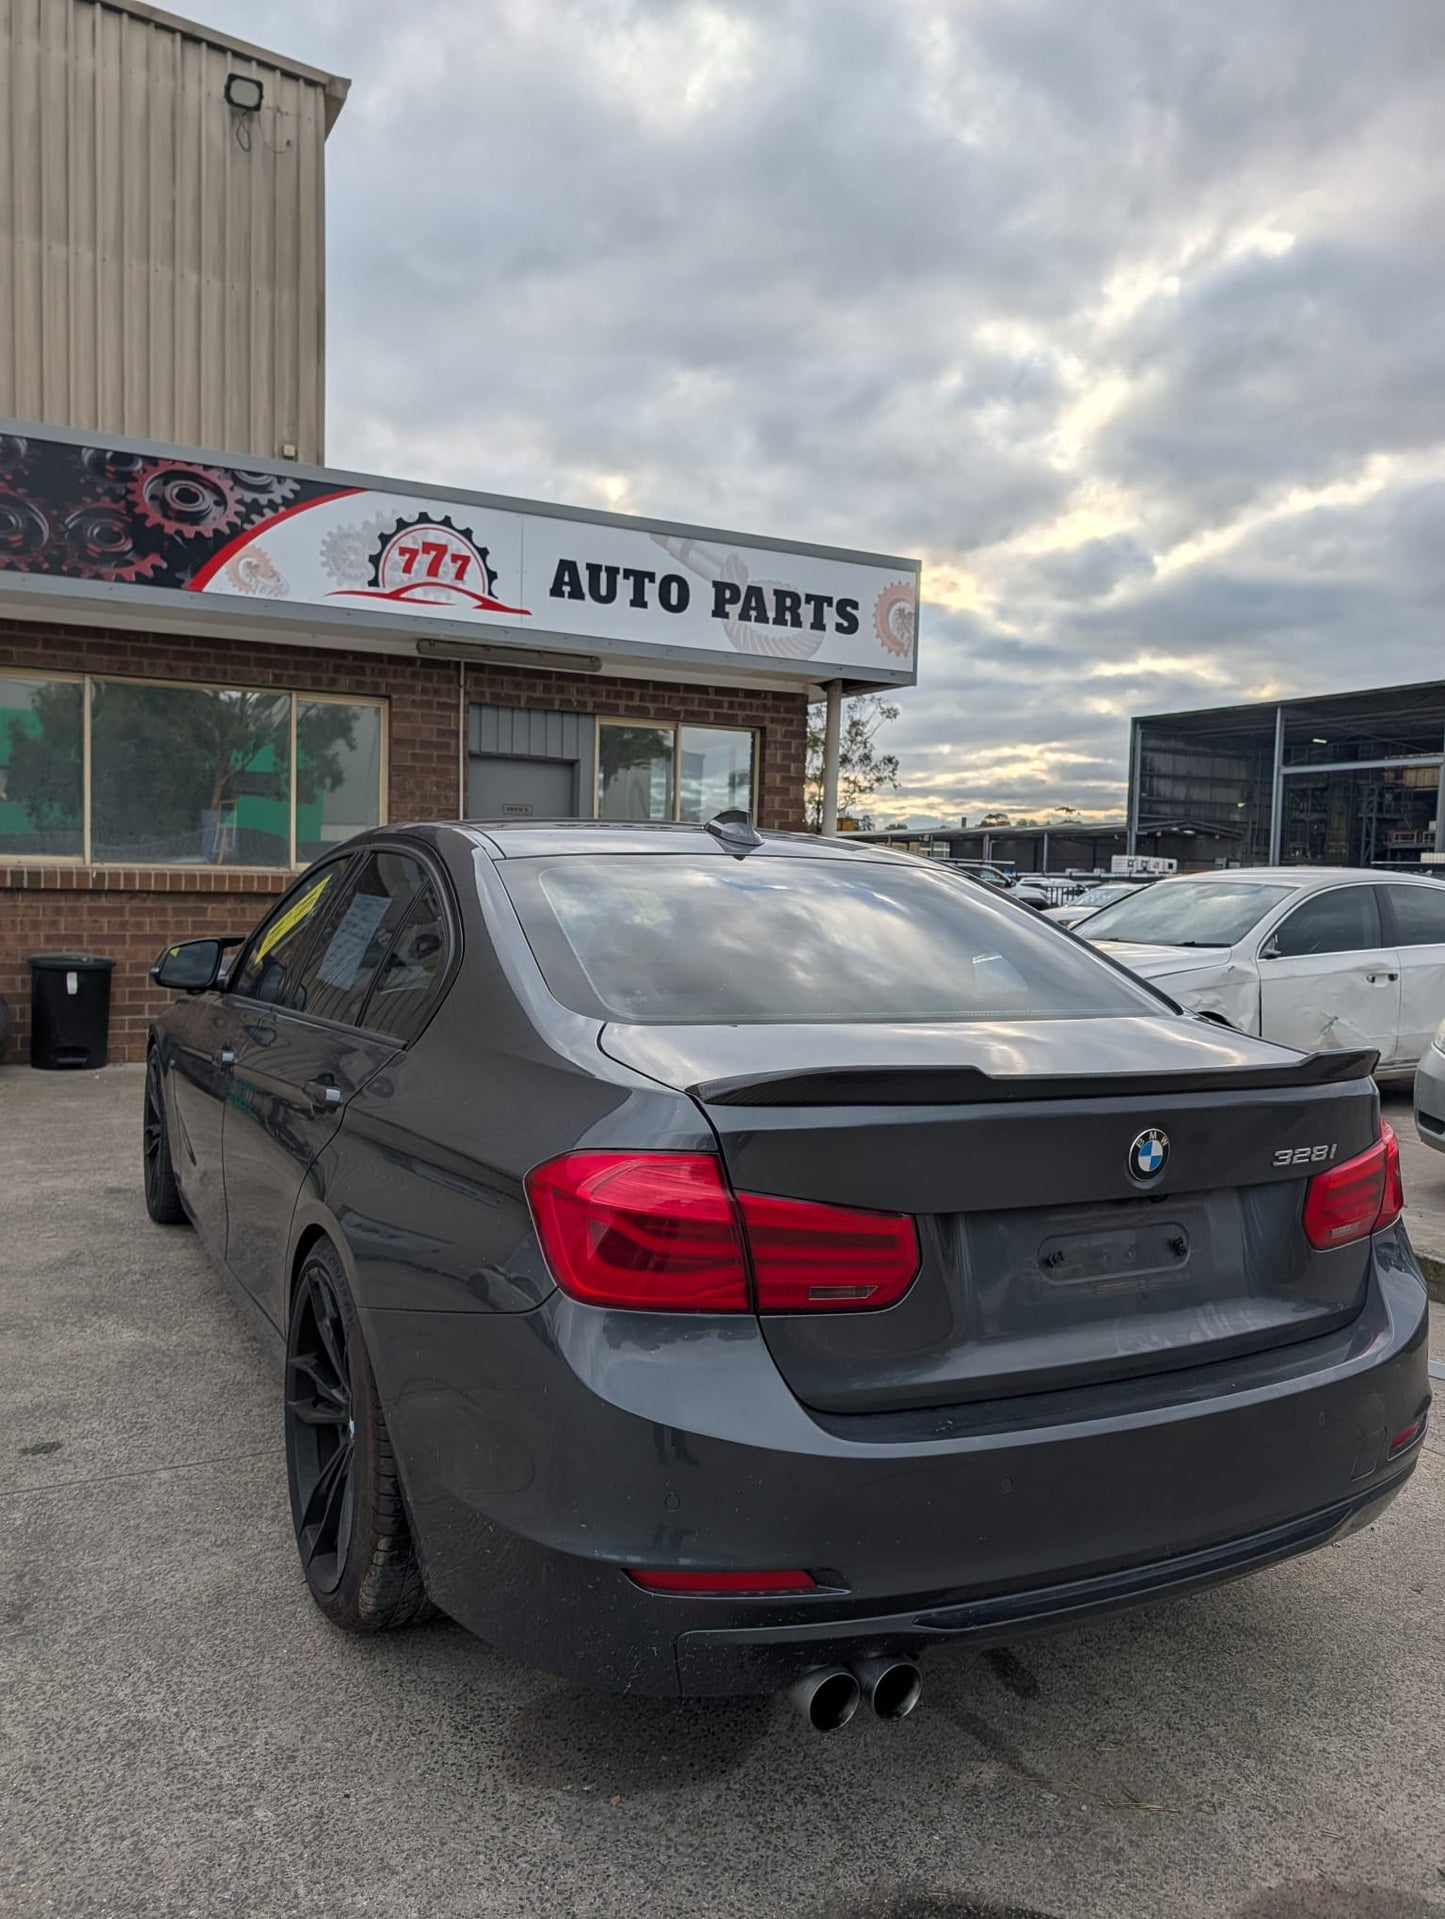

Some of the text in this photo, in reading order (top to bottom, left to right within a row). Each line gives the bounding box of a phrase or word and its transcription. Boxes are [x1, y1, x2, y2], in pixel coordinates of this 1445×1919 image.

[398, 541, 860, 635] 777 AUTO PARTS
[1135, 1130, 1169, 1149] BMW
